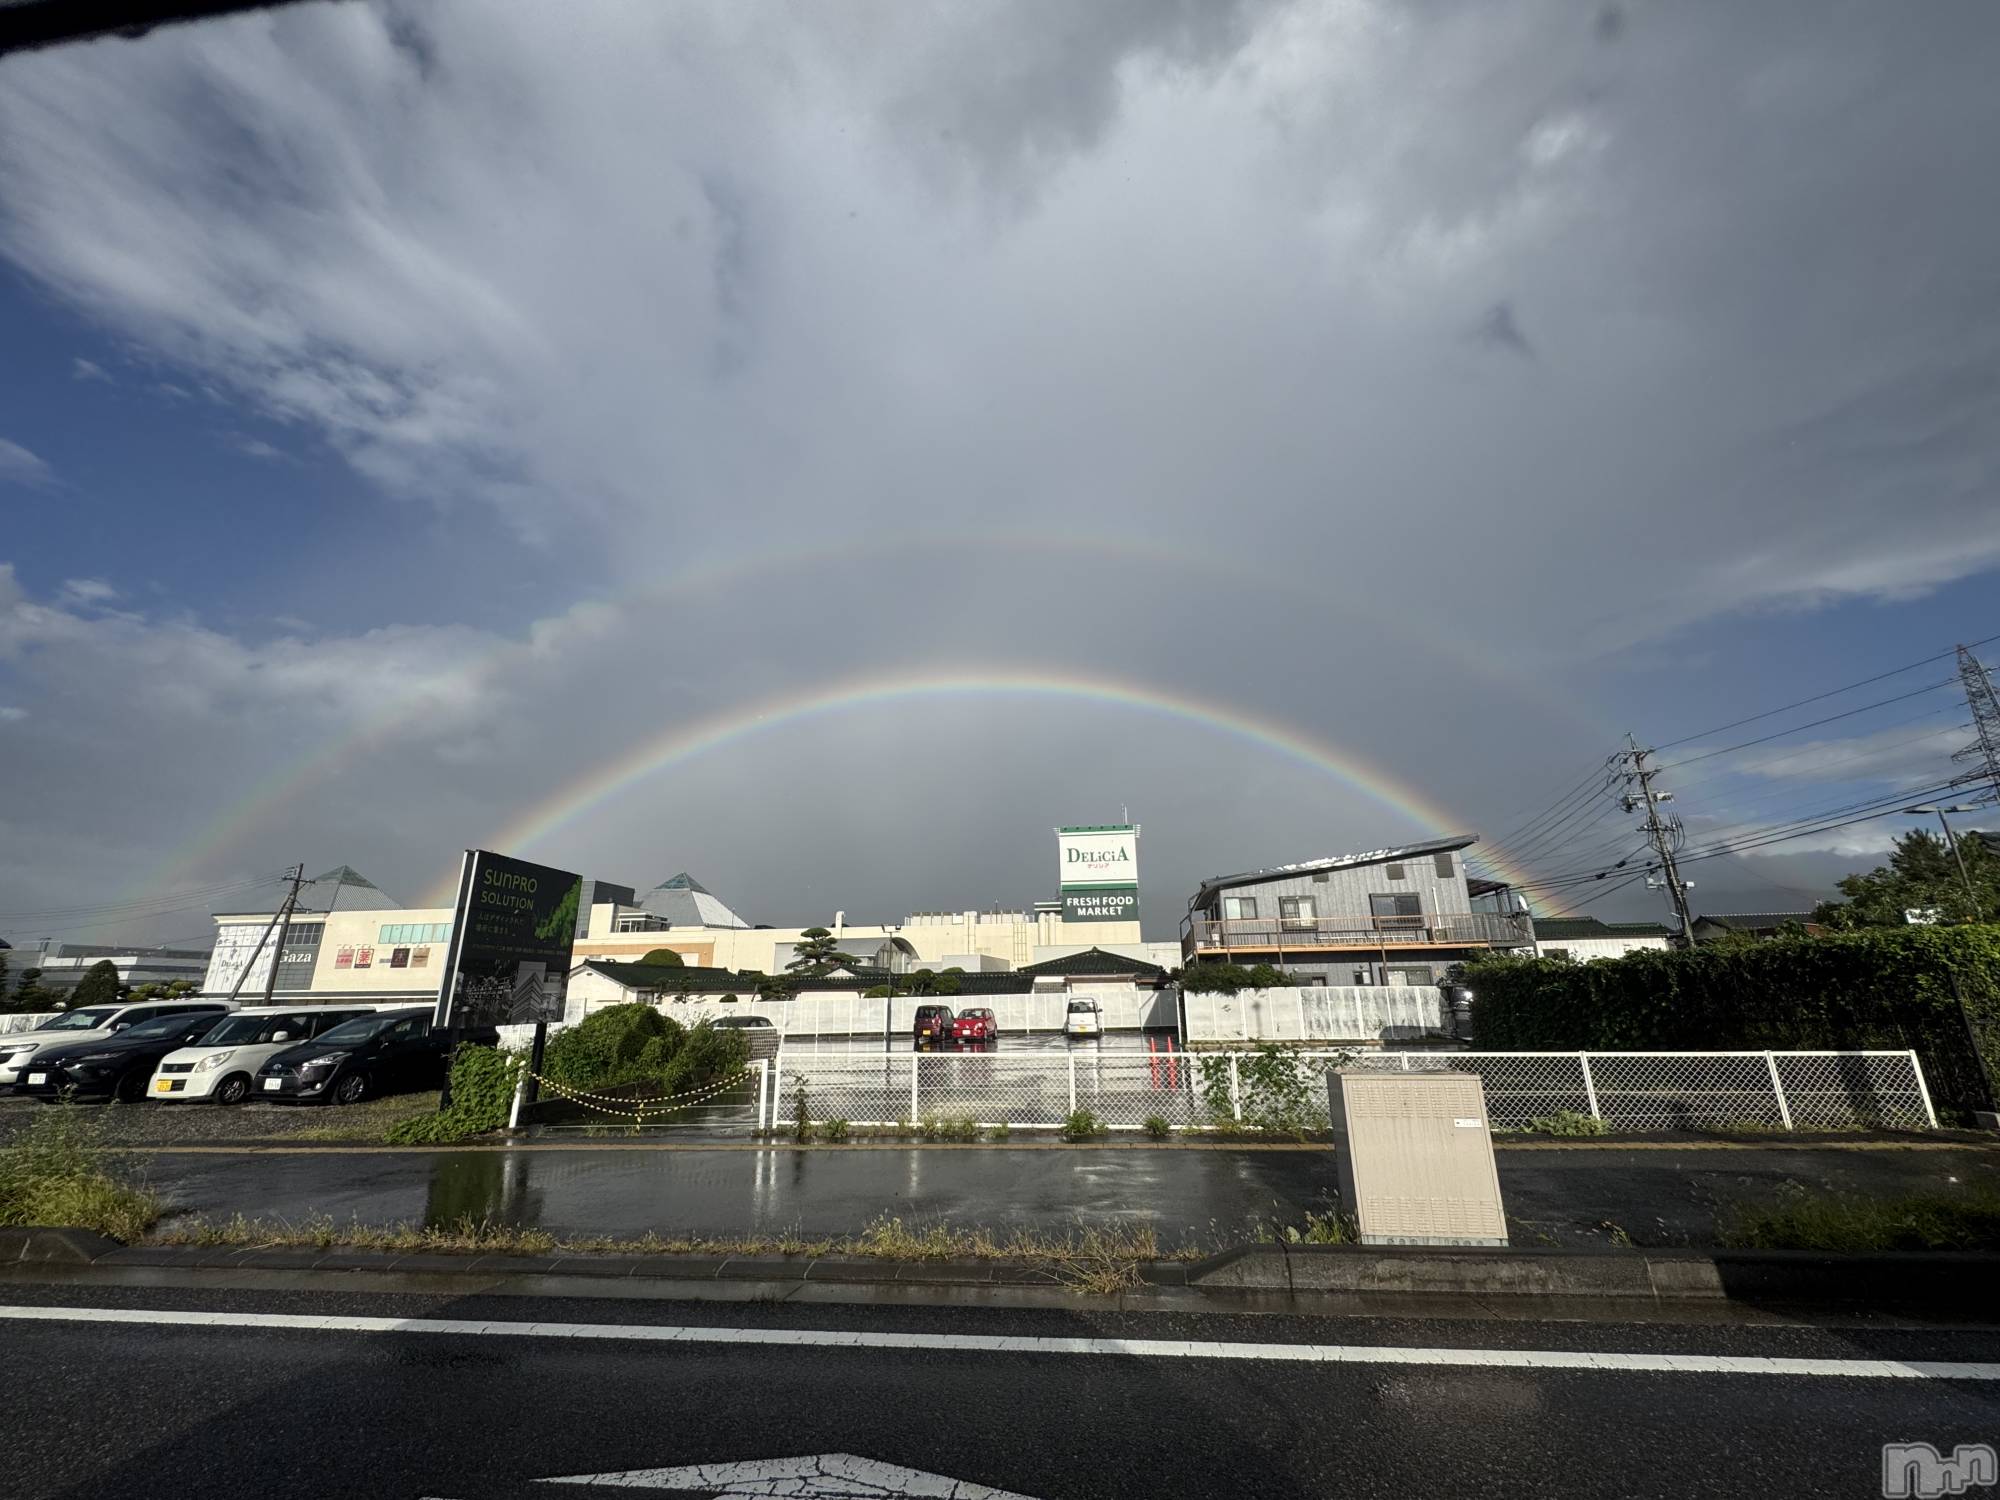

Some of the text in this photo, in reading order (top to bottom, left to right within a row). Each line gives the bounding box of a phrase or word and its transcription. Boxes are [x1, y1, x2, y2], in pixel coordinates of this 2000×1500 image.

[481, 891, 534, 910] SOLUTION
[1066, 896, 1134, 907] FRESH FOOD
[1077, 906, 1123, 916] MARKET
